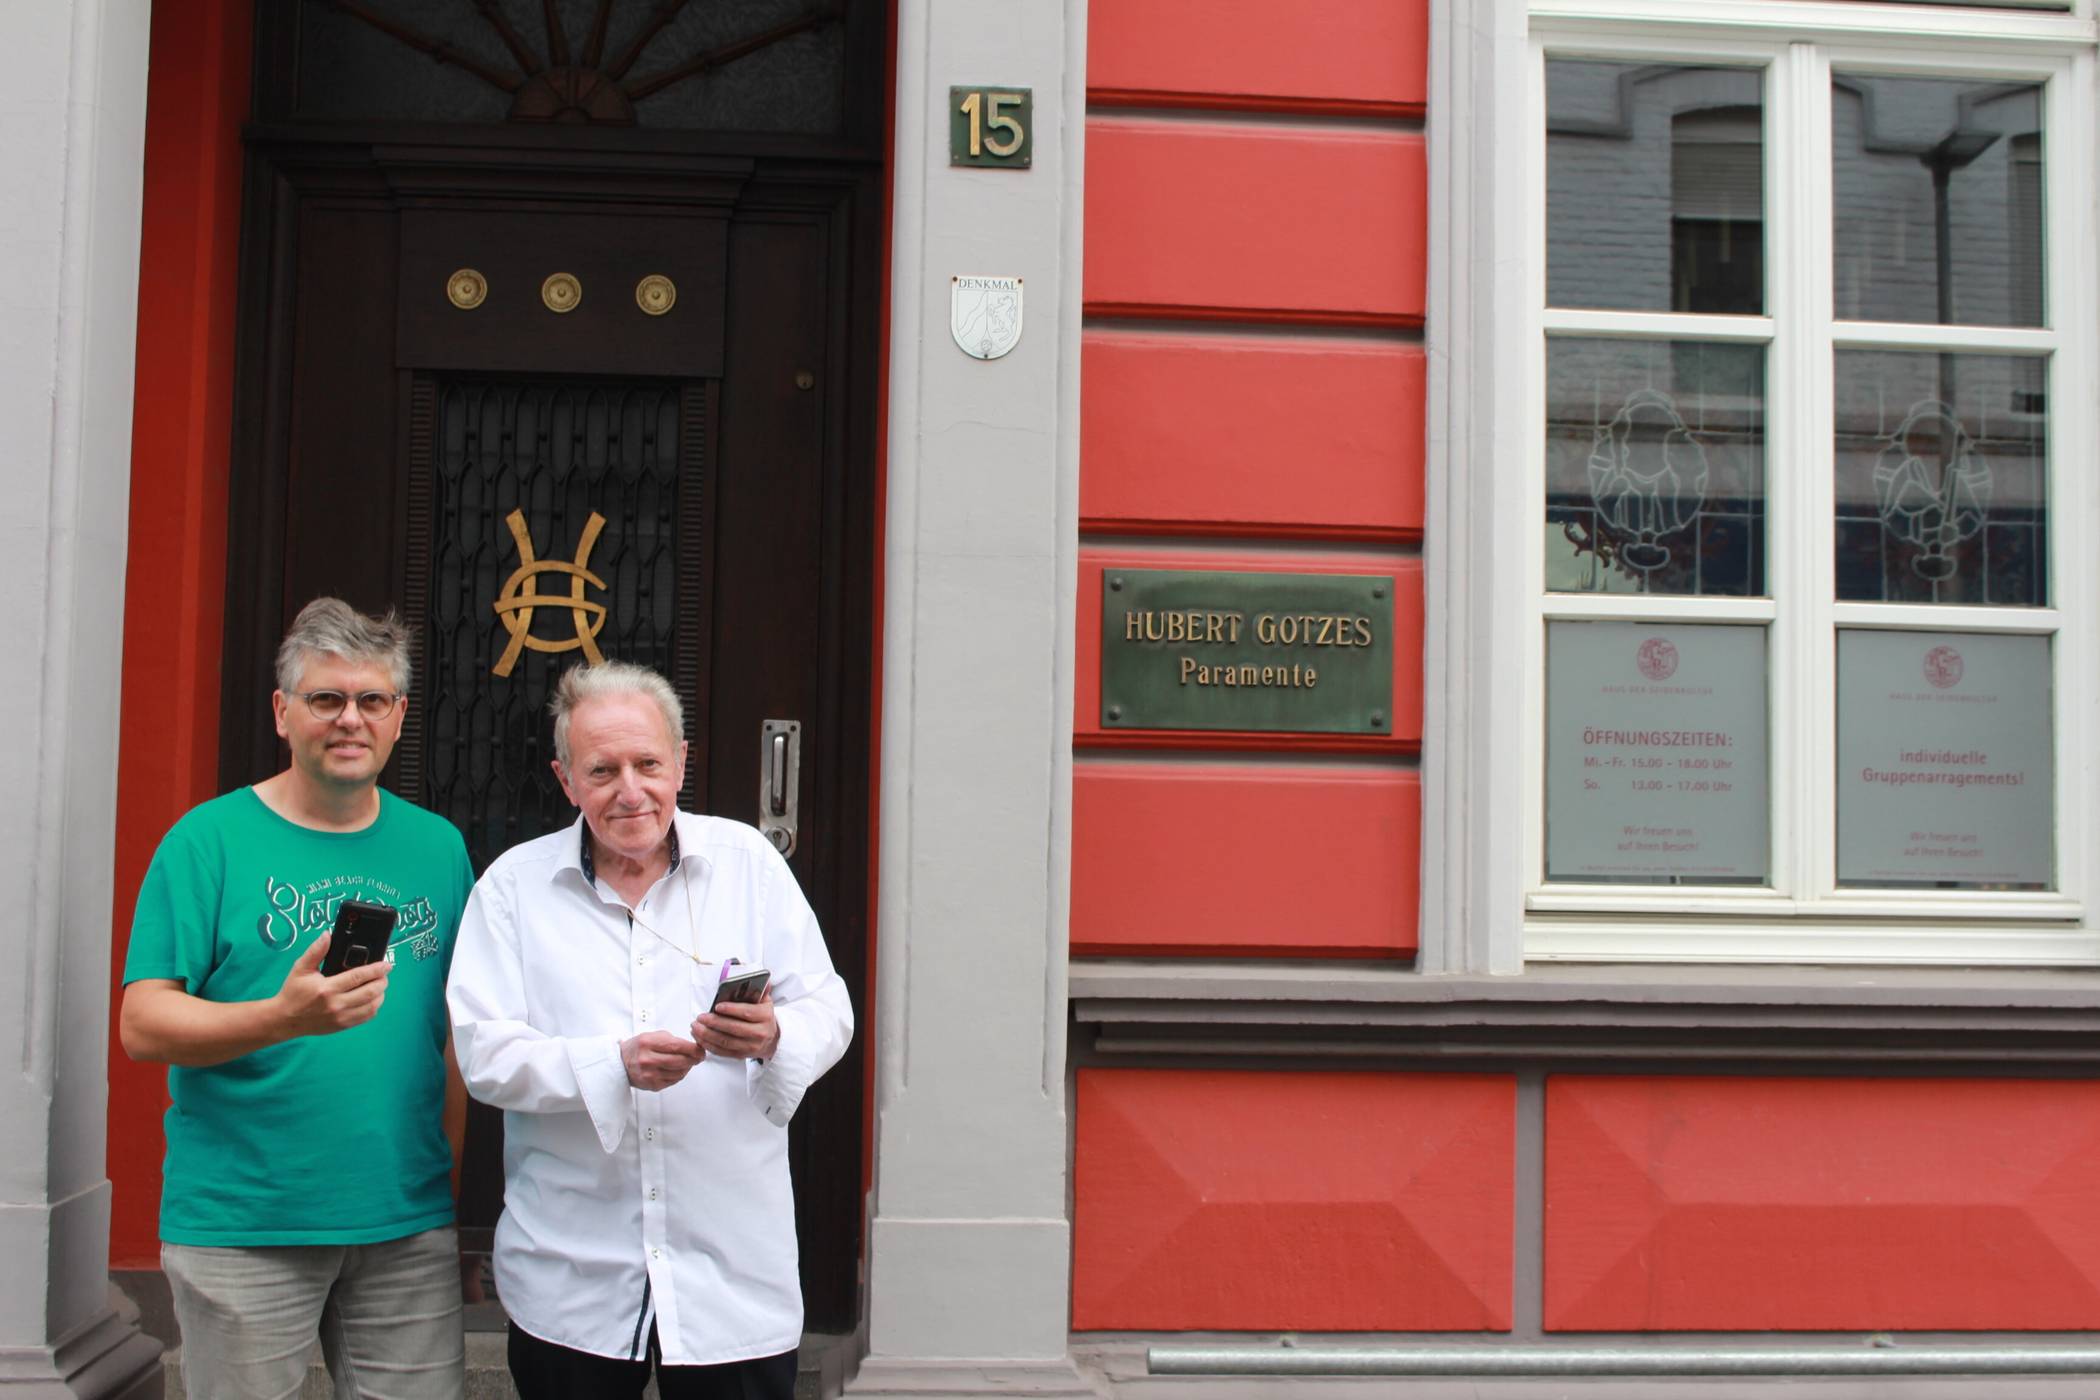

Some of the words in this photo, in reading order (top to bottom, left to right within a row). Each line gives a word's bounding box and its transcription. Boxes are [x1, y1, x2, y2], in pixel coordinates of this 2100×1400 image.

[960, 93, 1024, 157] 15
[958, 278, 1018, 291] DENKMAL
[1125, 611, 1242, 643] HUBERT
[1180, 656, 1317, 688] Paramente
[1583, 726, 1734, 747] ÖFFNUNGSZEITEN:
[1631, 758, 1663, 769] 15.00
[1678, 758, 1709, 769] 18.00
[1713, 758, 1733, 769] Uhr
[1900, 748, 1988, 765] individuelle
[1583, 779, 1601, 790] So.
[1713, 780, 1733, 791] Uhr
